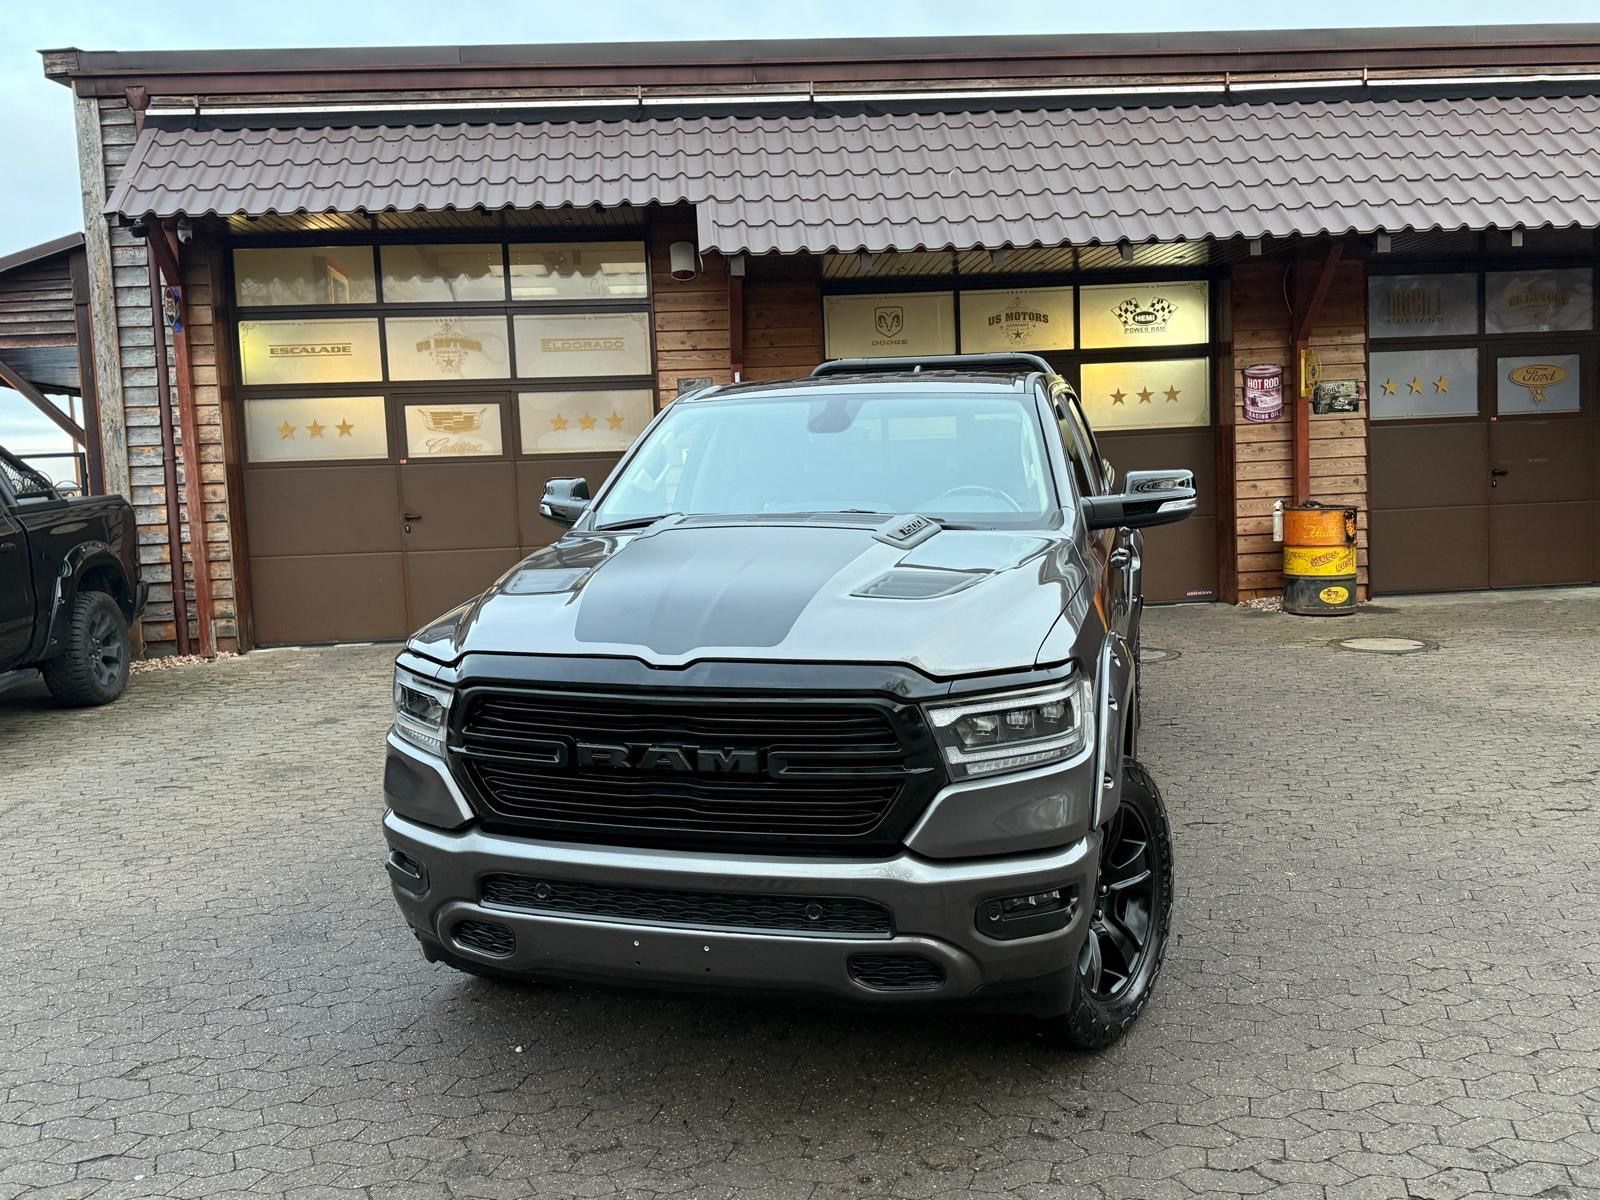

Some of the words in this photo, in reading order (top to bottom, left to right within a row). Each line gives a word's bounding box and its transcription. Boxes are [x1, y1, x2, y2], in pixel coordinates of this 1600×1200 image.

[988, 314, 1002, 326] US
[1005, 311, 1049, 323] MOTORS
[1135, 314, 1155, 322] HEMI
[269, 345, 352, 355] ESCALADE
[541, 340, 625, 352] ELDORADO
[1522, 367, 1557, 382] Ford
[1247, 378, 1262, 390] HOT
[1263, 377, 1279, 390] ROD
[1270, 410, 1280, 418] OIL
[425, 437, 483, 455] Cadillac
[899, 519, 923, 536] 1500
[576, 743, 757, 773] RAM
